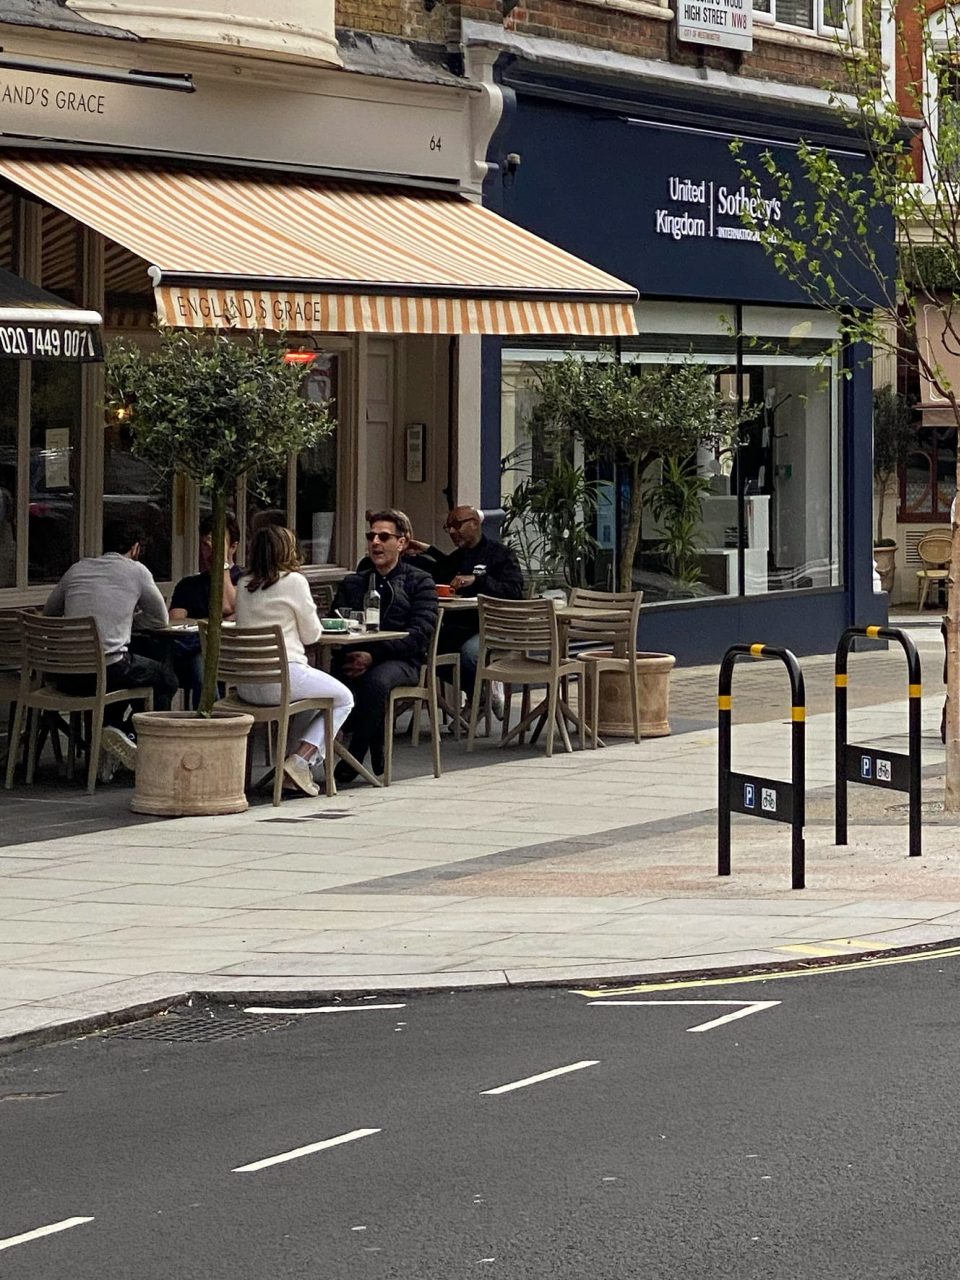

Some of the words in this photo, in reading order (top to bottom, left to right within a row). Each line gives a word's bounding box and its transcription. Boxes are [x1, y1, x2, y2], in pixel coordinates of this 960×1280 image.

[684, 4, 700, 22] HIGH
[703, 7, 727, 26] STREET
[731, 12, 747, 29] NW8
[56, 91, 105, 114] GRACE
[430, 135, 441, 152] 64
[669, 177, 705, 203] United
[656, 209, 705, 240] Kingdom
[177, 296, 267, 319] ENGLAND'S
[273, 299, 320, 322] GRACE
[0, 327, 28, 355] 020
[28, 328, 60, 356] 7449
